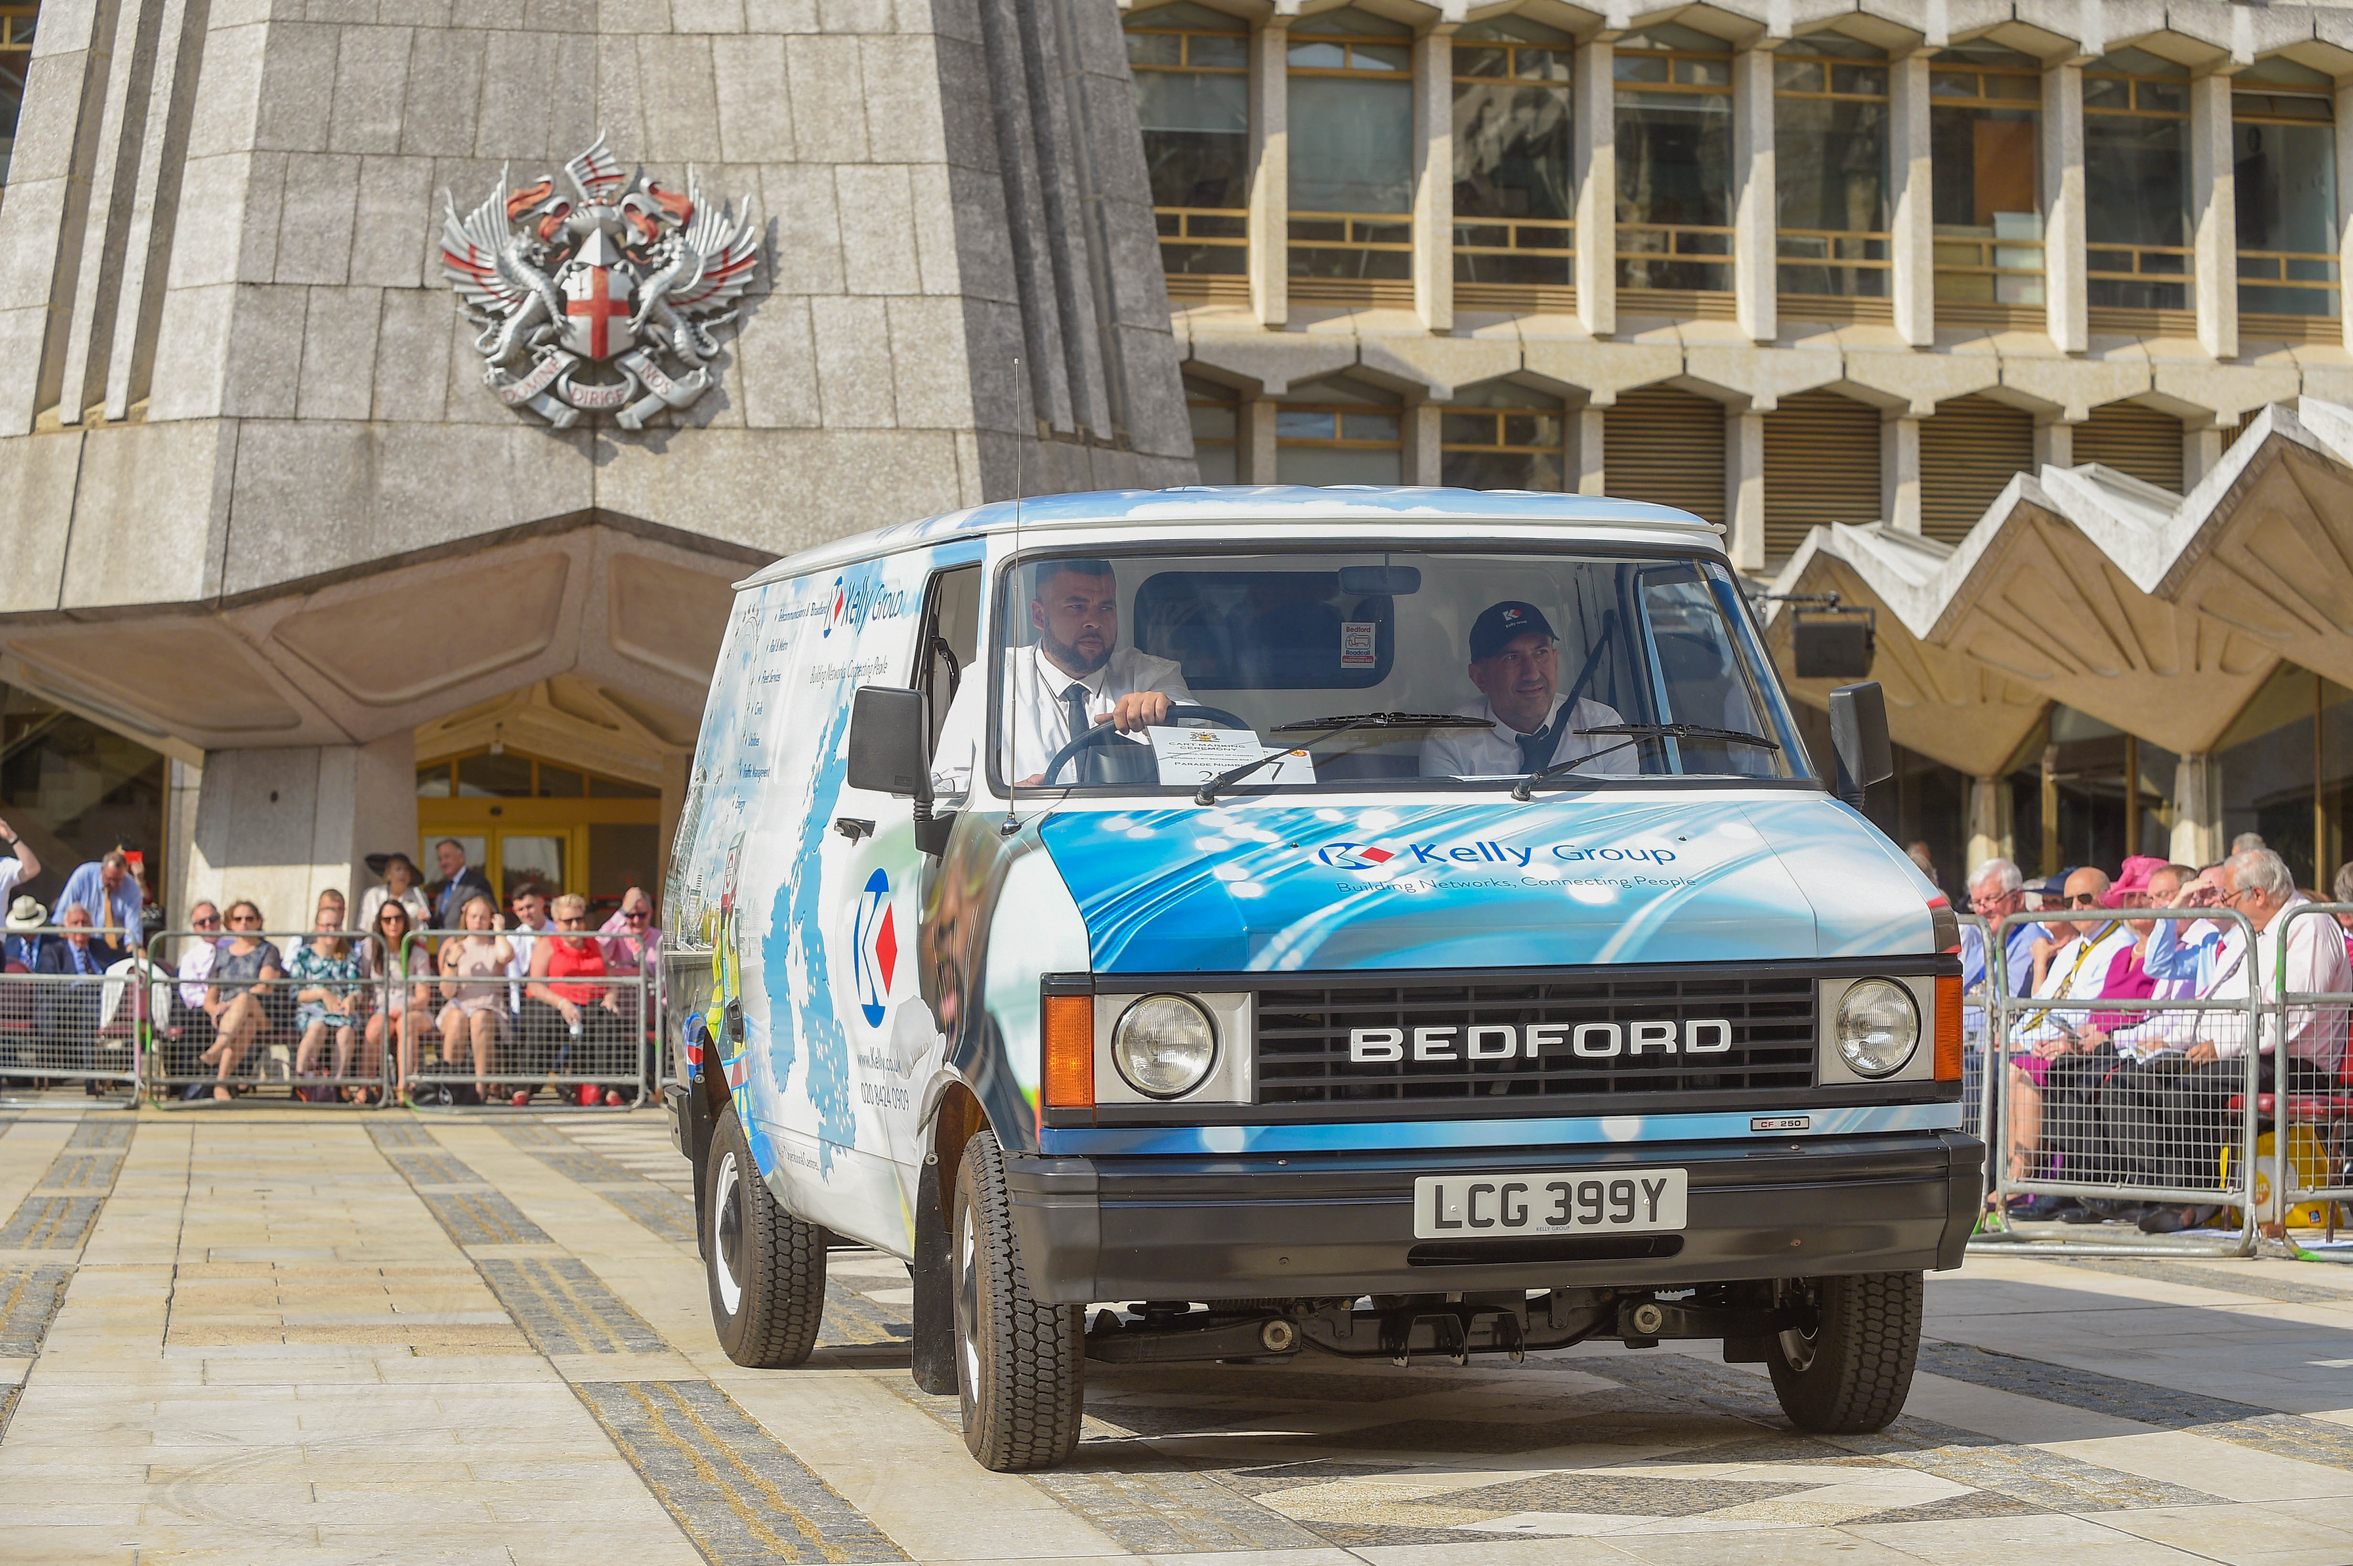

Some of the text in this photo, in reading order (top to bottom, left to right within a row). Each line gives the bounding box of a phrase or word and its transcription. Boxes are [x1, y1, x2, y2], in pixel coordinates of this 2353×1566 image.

[502, 358, 671, 406] DOMINE DIRIGE NOS
[841, 575, 904, 637] Kelly Group
[1409, 841, 1677, 868] Kelly Group
[1336, 875, 1697, 894] Building Networks, Connecting People
[1349, 1018, 1733, 1063] BEDFORD
[860, 1082, 910, 1112] 020 8424 0909
[1434, 1177, 1668, 1230] LCG 399Y
